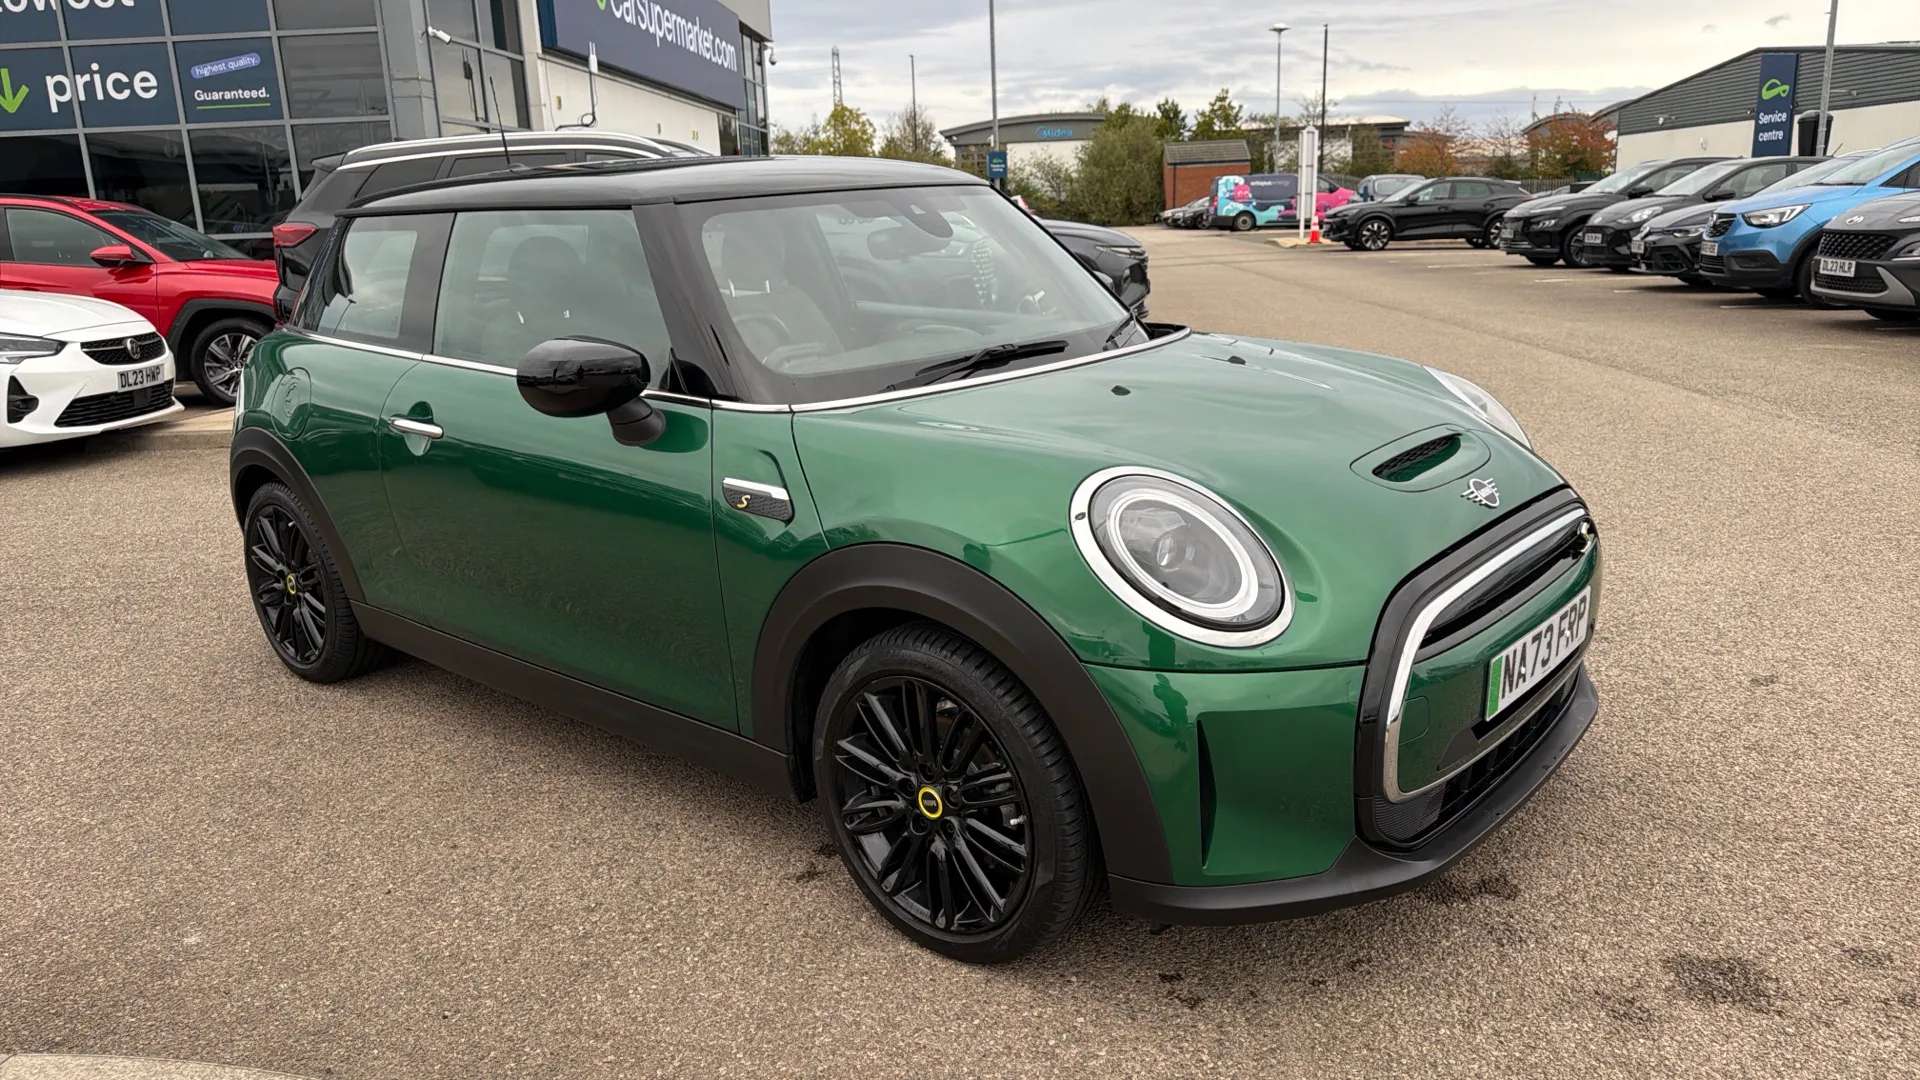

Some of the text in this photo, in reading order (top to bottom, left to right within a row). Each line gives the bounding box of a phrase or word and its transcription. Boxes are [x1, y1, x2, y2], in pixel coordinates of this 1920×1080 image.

[195, 62, 227, 77] highest
[45, 62, 158, 113] price
[194, 86, 270, 101] Guaranteed.
[1758, 110, 1787, 124] Service
[1758, 130, 1784, 142] centre
[120, 366, 161, 388] DL23 HWP
[736, 494, 751, 509] S
[1501, 594, 1587, 700] NA73 FRP
